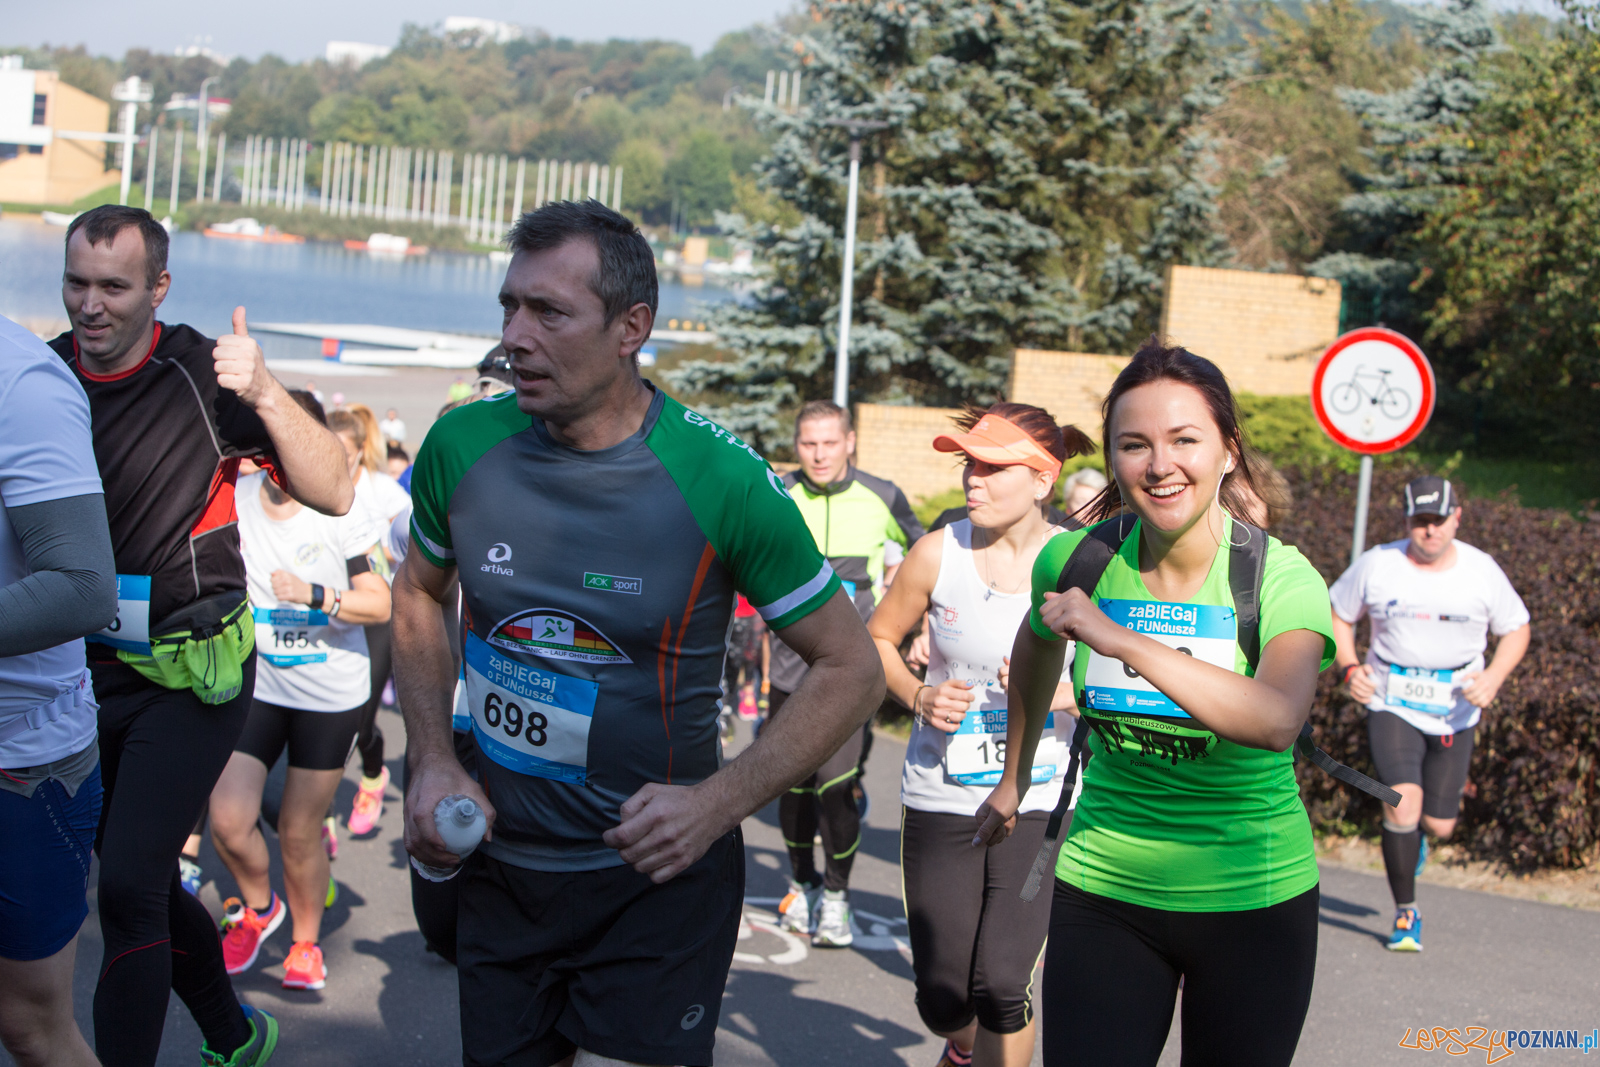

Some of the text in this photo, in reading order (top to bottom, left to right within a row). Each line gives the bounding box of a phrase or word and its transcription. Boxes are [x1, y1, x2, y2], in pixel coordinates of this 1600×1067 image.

[480, 563, 514, 577] artiva
[588, 576, 638, 591] AOK sport
[1128, 604, 1198, 626] zaBIEGaj
[1127, 620, 1196, 636] o FUNdusze
[271, 629, 309, 649] 165
[550, 650, 568, 658] LAUF
[568, 652, 589, 660] OHNE
[489, 655, 557, 694] zaBIEGaj
[487, 670, 554, 703] o FUNdusze
[1404, 682, 1435, 699] 503
[484, 692, 548, 747] 698
[973, 711, 1007, 724] zaBIE
[1119, 716, 1178, 733] Jubileuszowy
[982, 723, 1007, 733] FUNd
[976, 739, 1007, 765] 18
